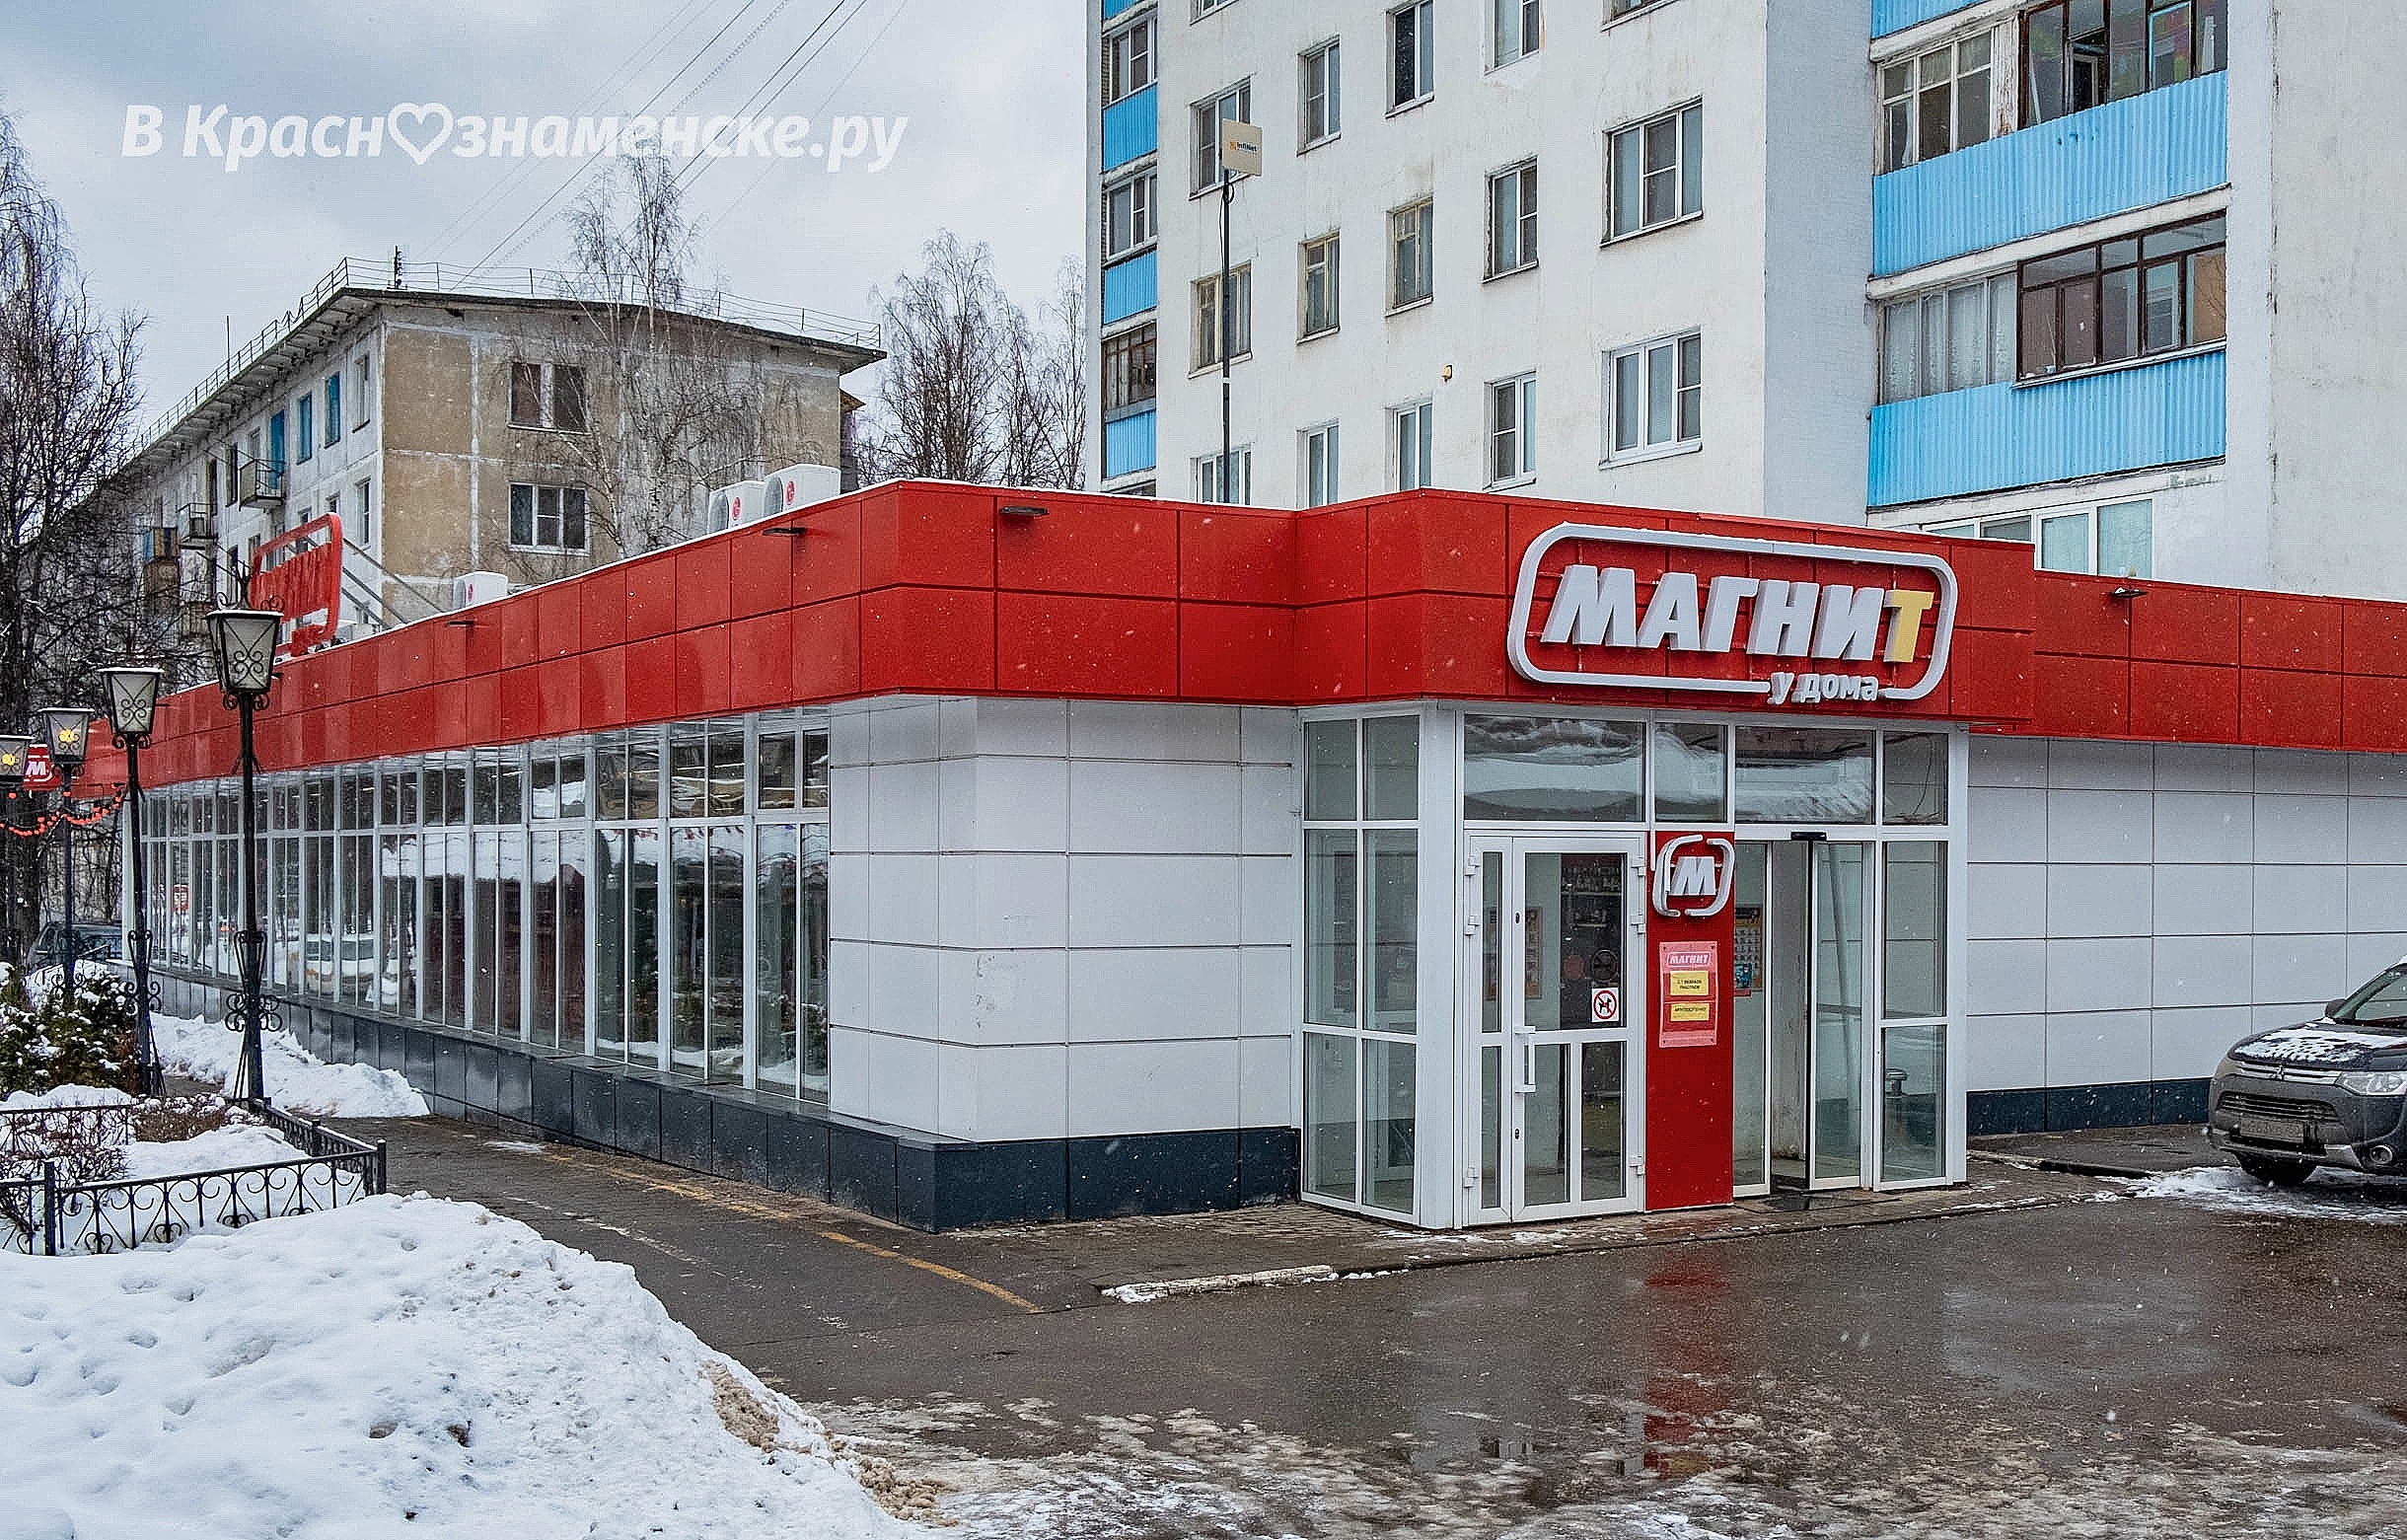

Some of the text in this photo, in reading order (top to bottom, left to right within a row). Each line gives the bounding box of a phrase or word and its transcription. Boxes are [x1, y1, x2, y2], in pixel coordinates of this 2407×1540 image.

[1540, 563, 1934, 664] МАГНИТ
[1791, 673, 1879, 703] дома
[1669, 855, 1717, 897] М
[1669, 954, 1710, 965] МАГНИТ
